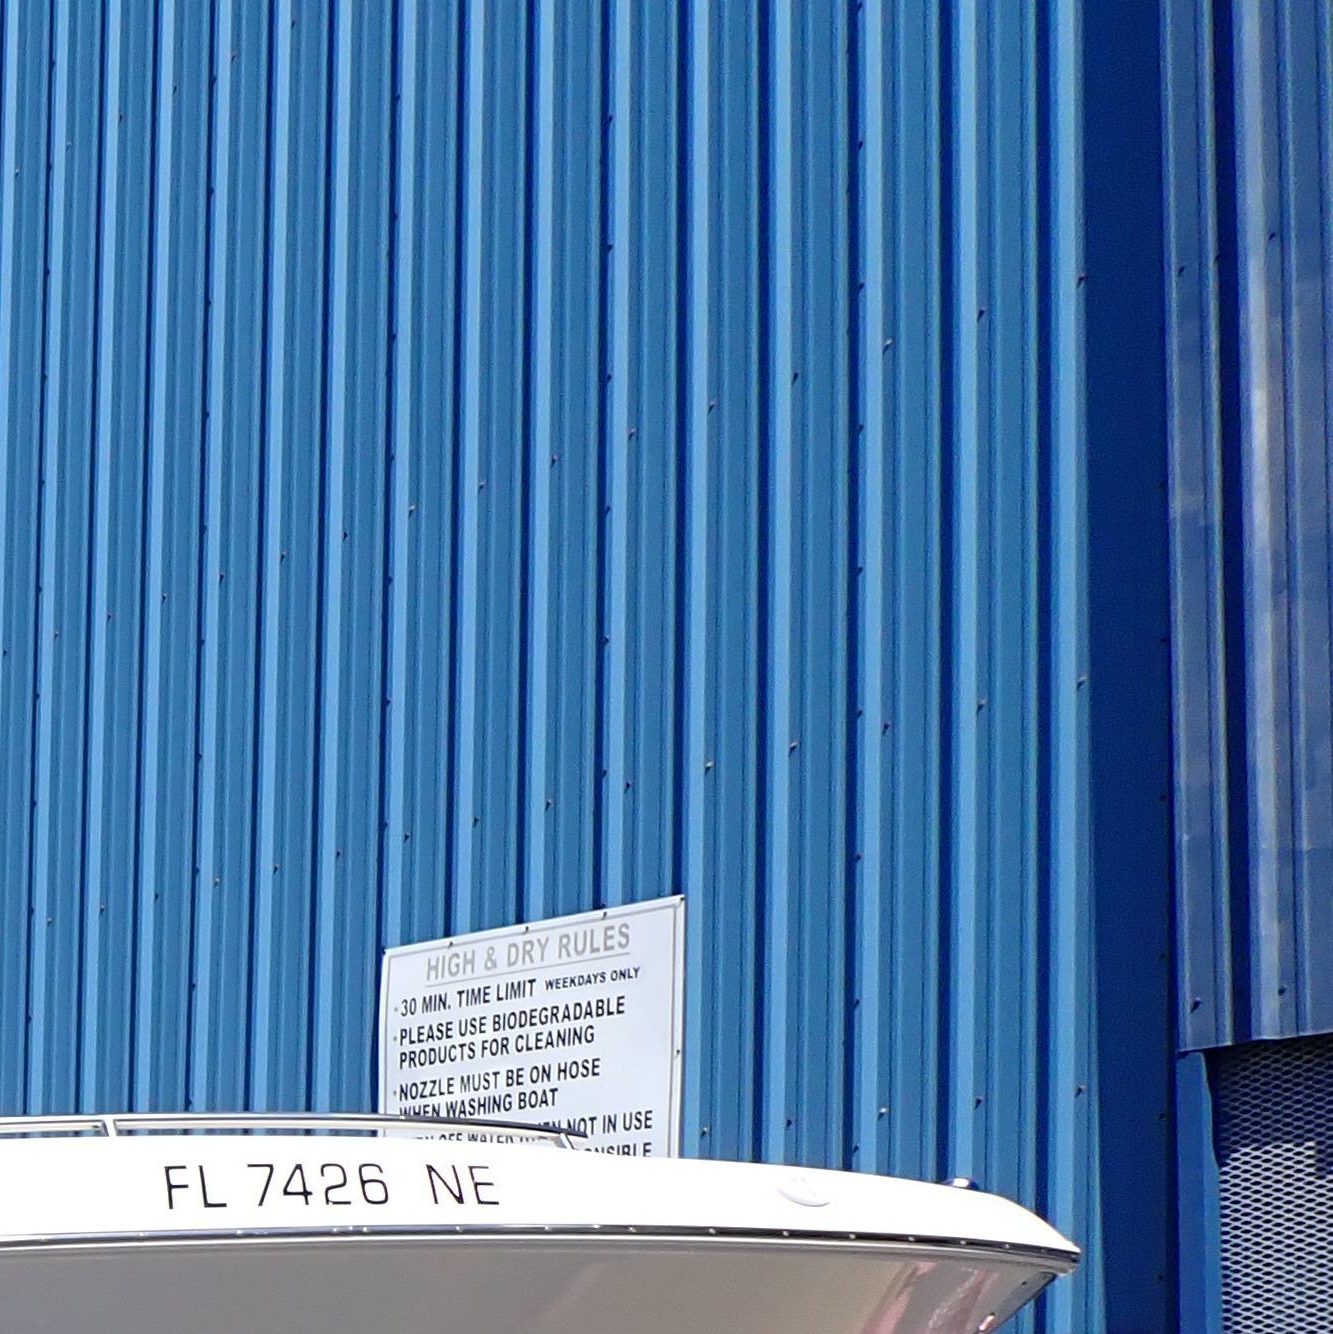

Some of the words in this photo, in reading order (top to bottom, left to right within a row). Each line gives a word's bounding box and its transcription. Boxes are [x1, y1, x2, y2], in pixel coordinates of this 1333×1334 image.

[427, 949, 475, 982] HIGH
[485, 946, 497, 971] &
[508, 937, 550, 968] DRY
[558, 923, 630, 959] RULES
[401, 998, 417, 1017] 30
[421, 992, 451, 1014] MIN.
[457, 986, 491, 1008] TIME
[496, 979, 537, 1002] LIMIT
[545, 972, 606, 991] WEEKDAYS
[611, 967, 641, 982] ONLY
[400, 1022, 454, 1046] PLEASE
[459, 1016, 487, 1037] USE
[493, 996, 626, 1032] BIODEGRADABLE
[399, 1041, 476, 1069] PRODUCTS
[481, 1038, 509, 1059] FOR
[515, 1025, 595, 1053] CLEANING
[399, 1077, 455, 1101] NOZZLE
[460, 1071, 500, 1095] MUST
[506, 1069, 525, 1088] BE
[530, 1065, 551, 1083] ON
[557, 1058, 600, 1081] HOSE
[446, 1093, 513, 1119] WASHING
[518, 1088, 559, 1111] BOAT
[603, 1114, 617, 1134] IN
[623, 1110, 653, 1131] USE
[164, 1165, 227, 1209] FL
[246, 1163, 390, 1206] 7426
[425, 1164, 500, 1205] NE
